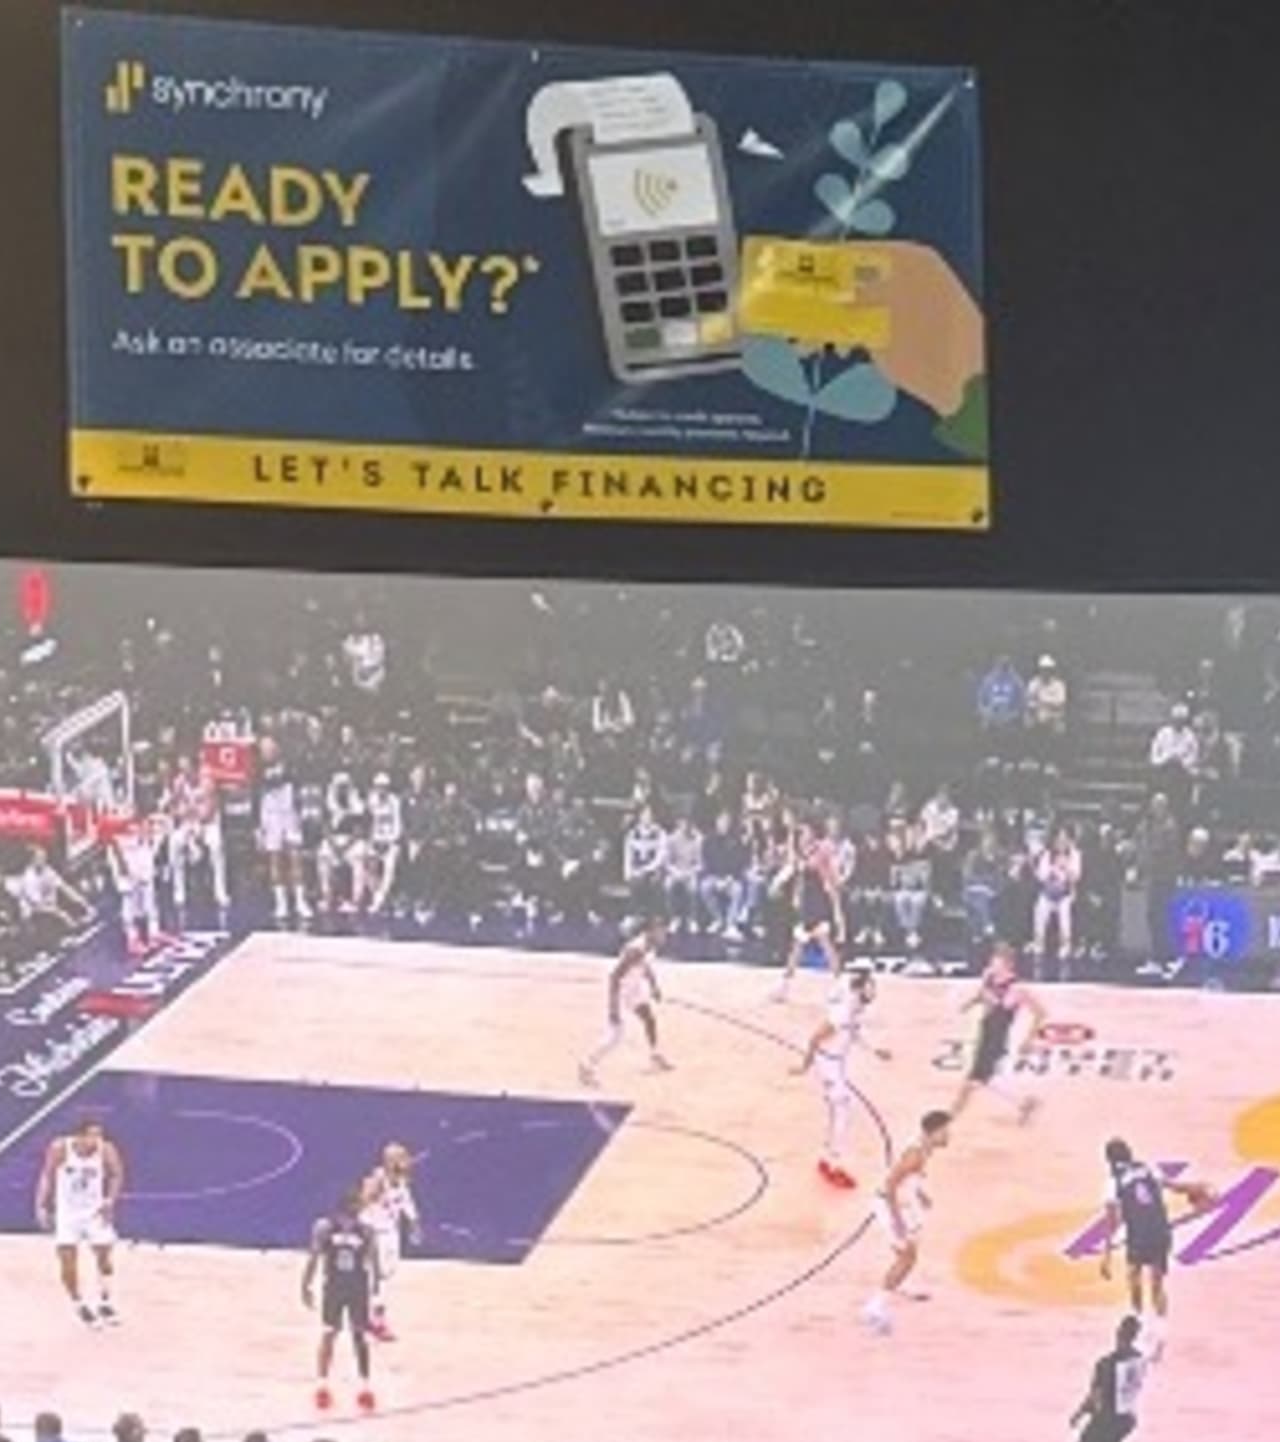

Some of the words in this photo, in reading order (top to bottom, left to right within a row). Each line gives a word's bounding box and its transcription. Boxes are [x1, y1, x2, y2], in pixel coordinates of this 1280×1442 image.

[153, 76, 328, 120] synchrony
[111, 155, 370, 228] READY
[111, 233, 218, 299] TO
[112, 330, 159, 356] Ask
[167, 337, 201, 355] an
[208, 335, 337, 366] associate
[342, 339, 380, 365] for
[253, 454, 384, 489] LET'S
[412, 462, 524, 494] TALK
[551, 469, 828, 503] FINANCING
